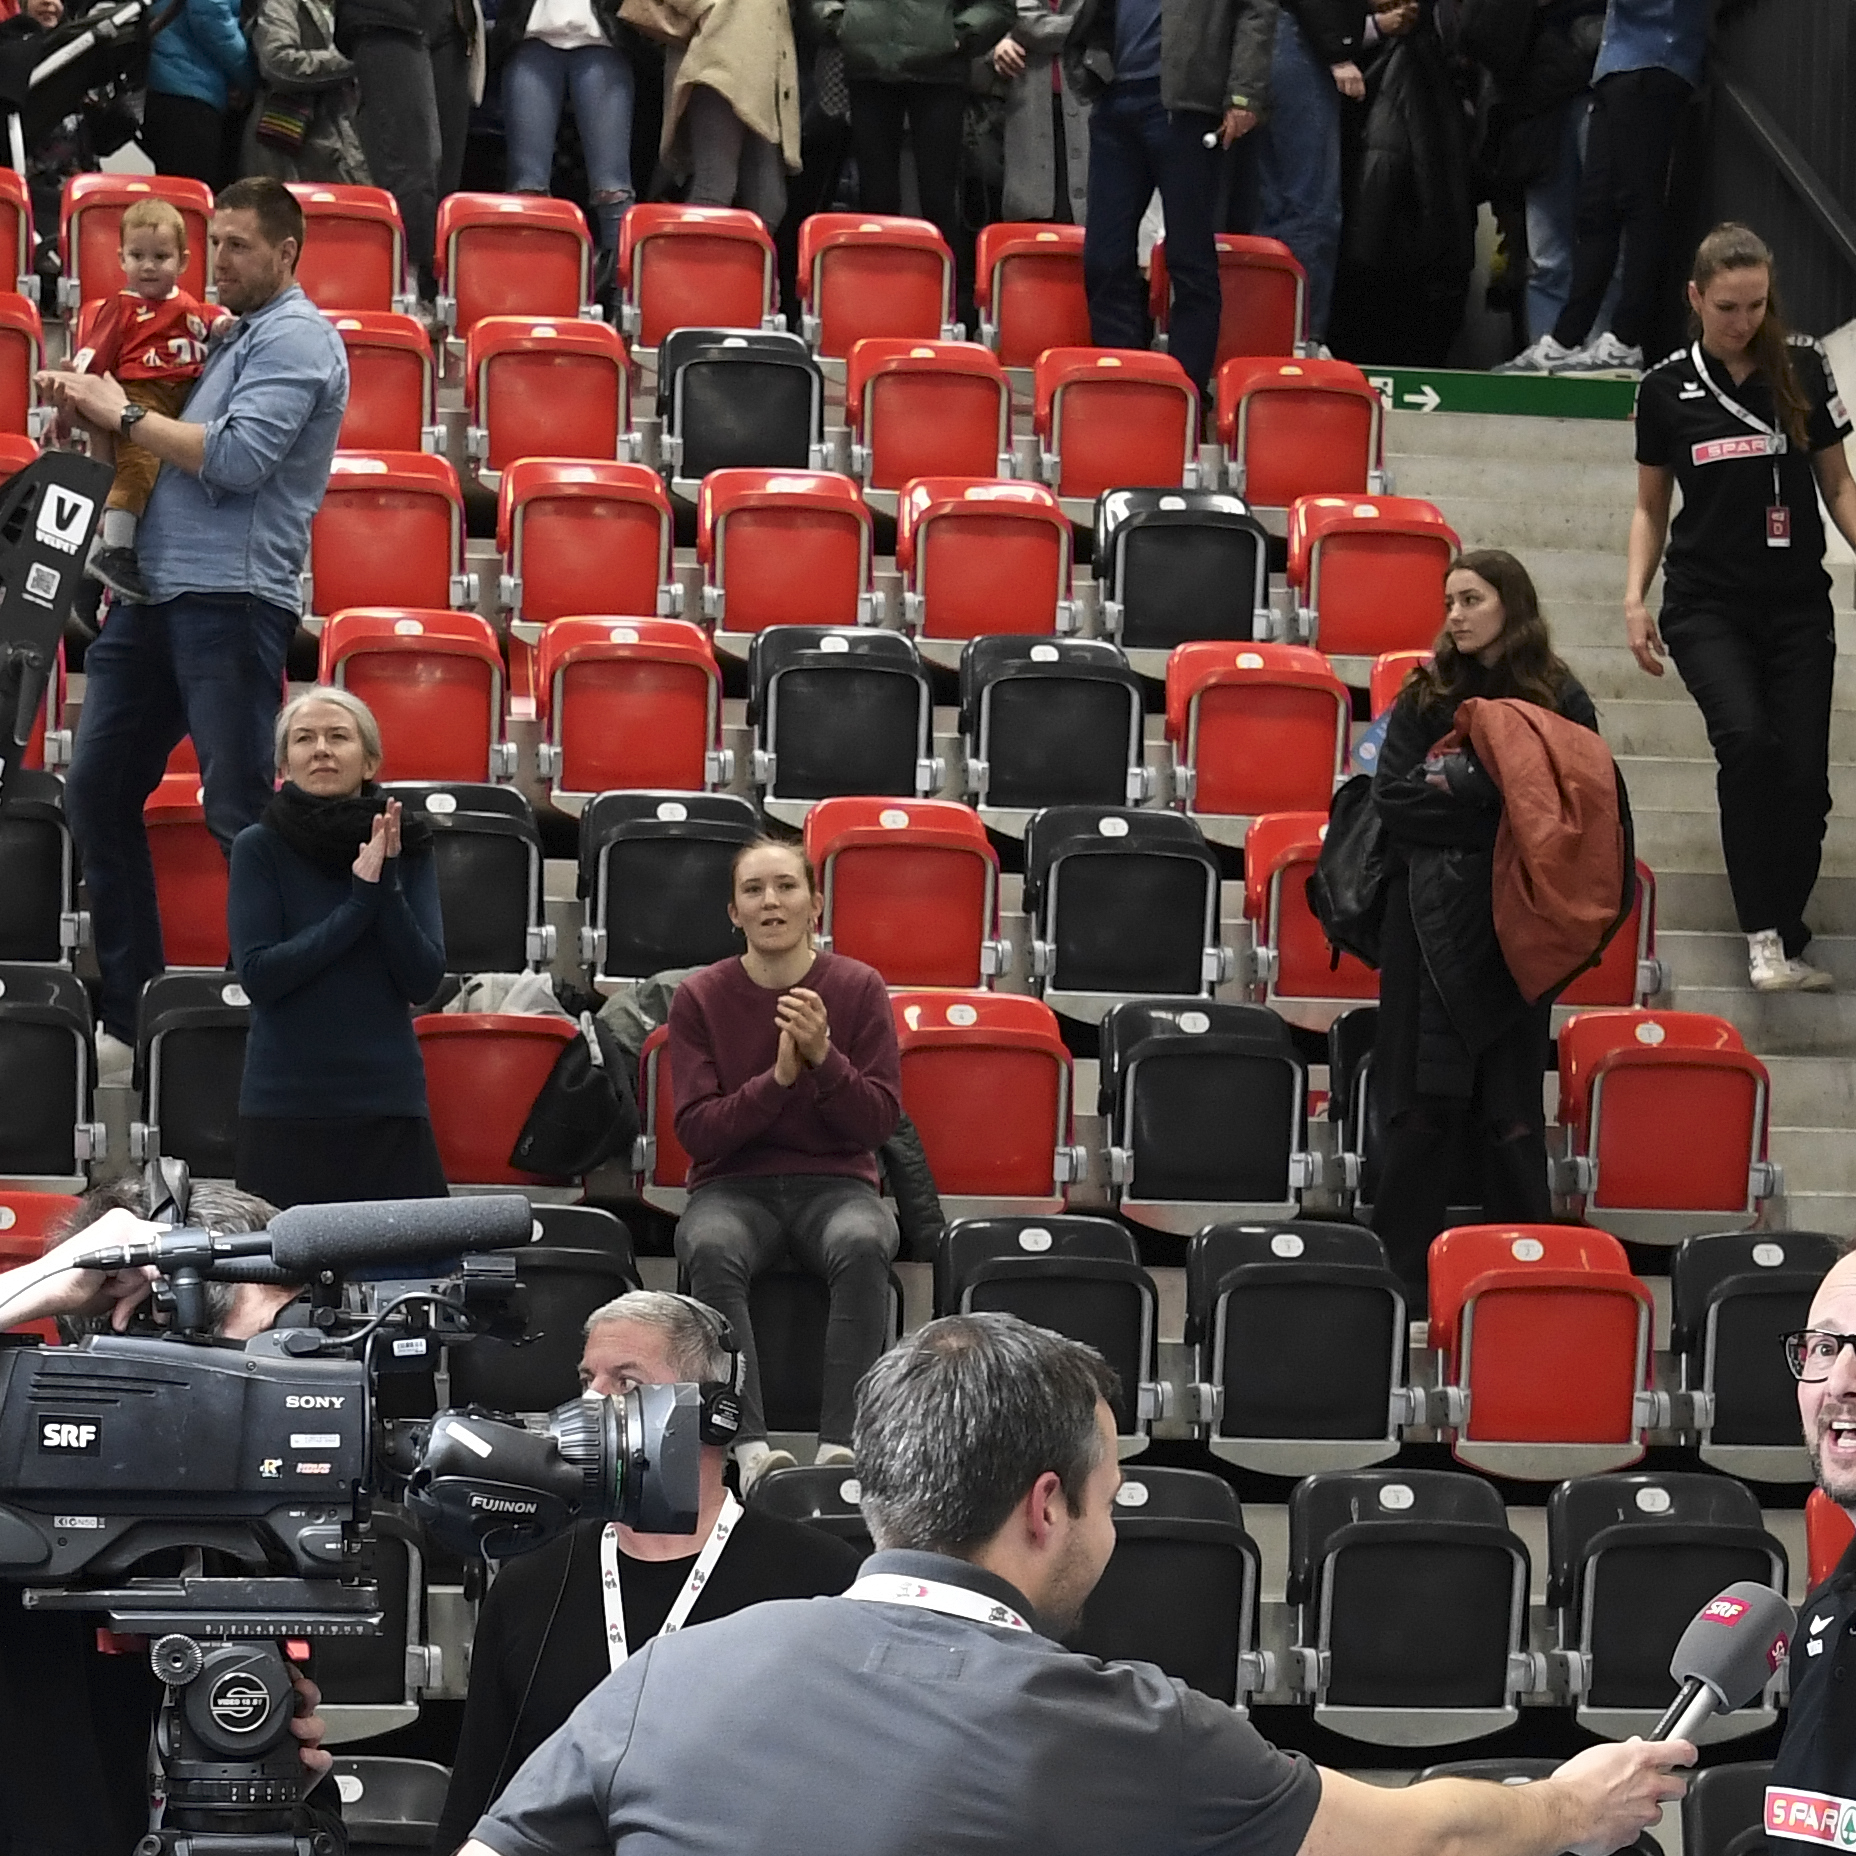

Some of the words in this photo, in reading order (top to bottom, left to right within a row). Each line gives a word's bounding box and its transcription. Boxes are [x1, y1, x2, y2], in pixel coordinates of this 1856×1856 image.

[1707, 440, 1766, 458] SPAR
[286, 1396, 345, 1409] SONY
[44, 1424, 96, 1447] SRF
[471, 1496, 537, 1514] FUJINON
[1705, 1601, 1744, 1618] SRF
[1772, 1799, 1839, 1835] SPAR
